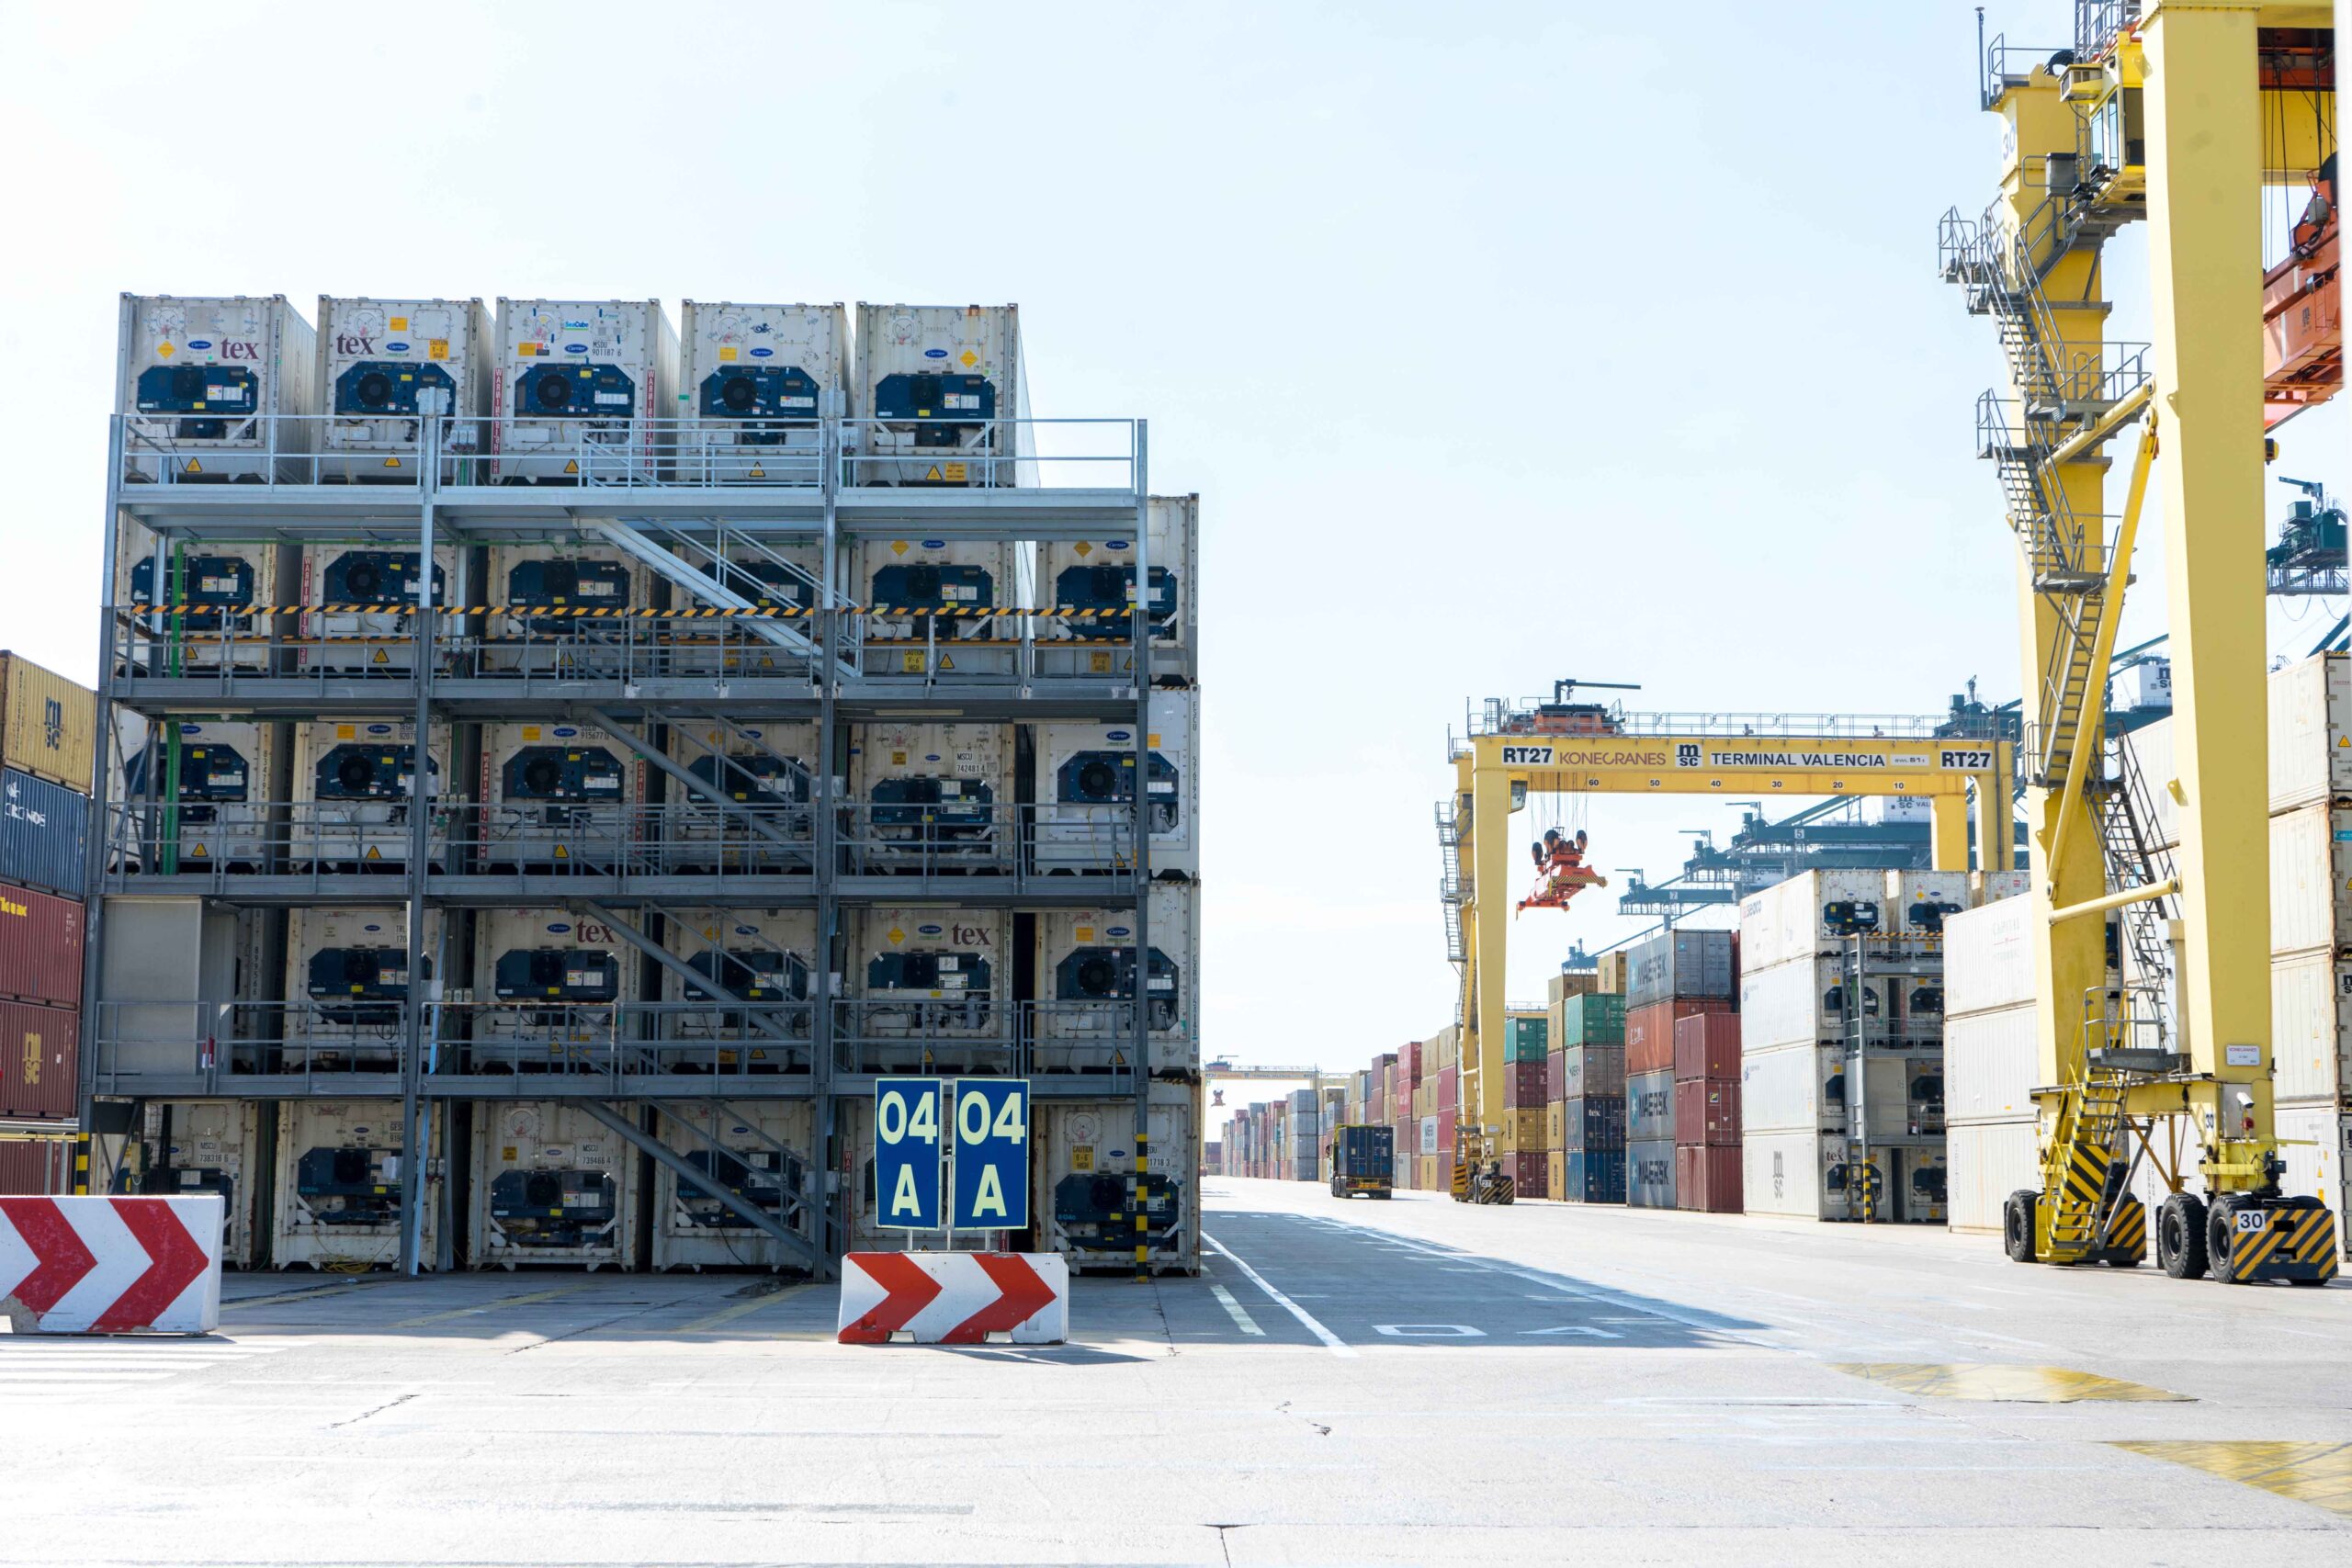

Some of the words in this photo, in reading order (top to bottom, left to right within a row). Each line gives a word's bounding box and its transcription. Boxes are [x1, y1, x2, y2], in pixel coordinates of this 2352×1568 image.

[220, 338, 259, 360] tex
[337, 333, 375, 355] tex
[1503, 747, 1553, 763] RT27
[1560, 752, 1666, 766] KONECRANES
[1711, 752, 1797, 766] TERMINAL
[1802, 754, 1885, 767] VALENCIA
[1942, 751, 1990, 768] RT27
[5, 802, 46, 827] CRONOS
[1797, 829, 1802, 838] 5
[576, 919, 615, 943] tex
[951, 922, 991, 945] tex
[878, 1090, 938, 1145] 04
[958, 1090, 1026, 1145] 04
[2205, 1114, 2215, 1129] 30
[1826, 1151, 1843, 1162] tex
[891, 1163, 921, 1217] A
[972, 1164, 1007, 1217] A
[2239, 1213, 2262, 1229] 30
